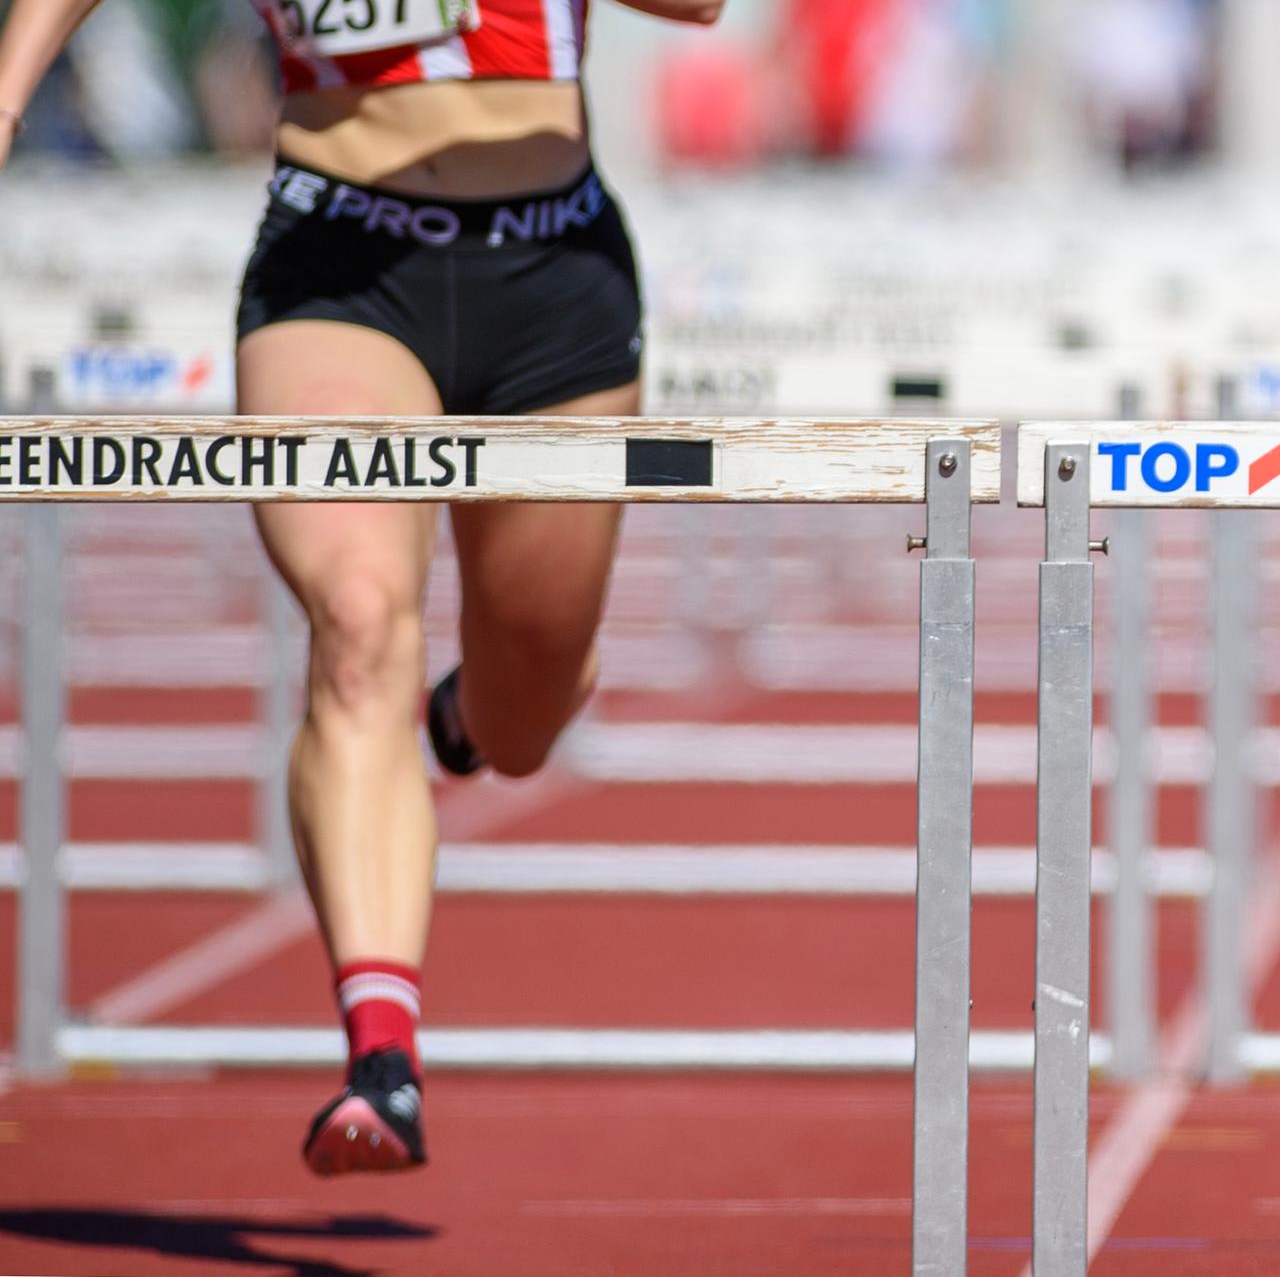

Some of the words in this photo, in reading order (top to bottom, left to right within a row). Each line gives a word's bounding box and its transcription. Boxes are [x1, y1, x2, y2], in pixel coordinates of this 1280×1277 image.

[324, 183, 461, 247] PRO
[0, 437, 307, 486] EENDRACHT
[325, 437, 486, 487] AALST
[1099, 443, 1239, 492] TOP
